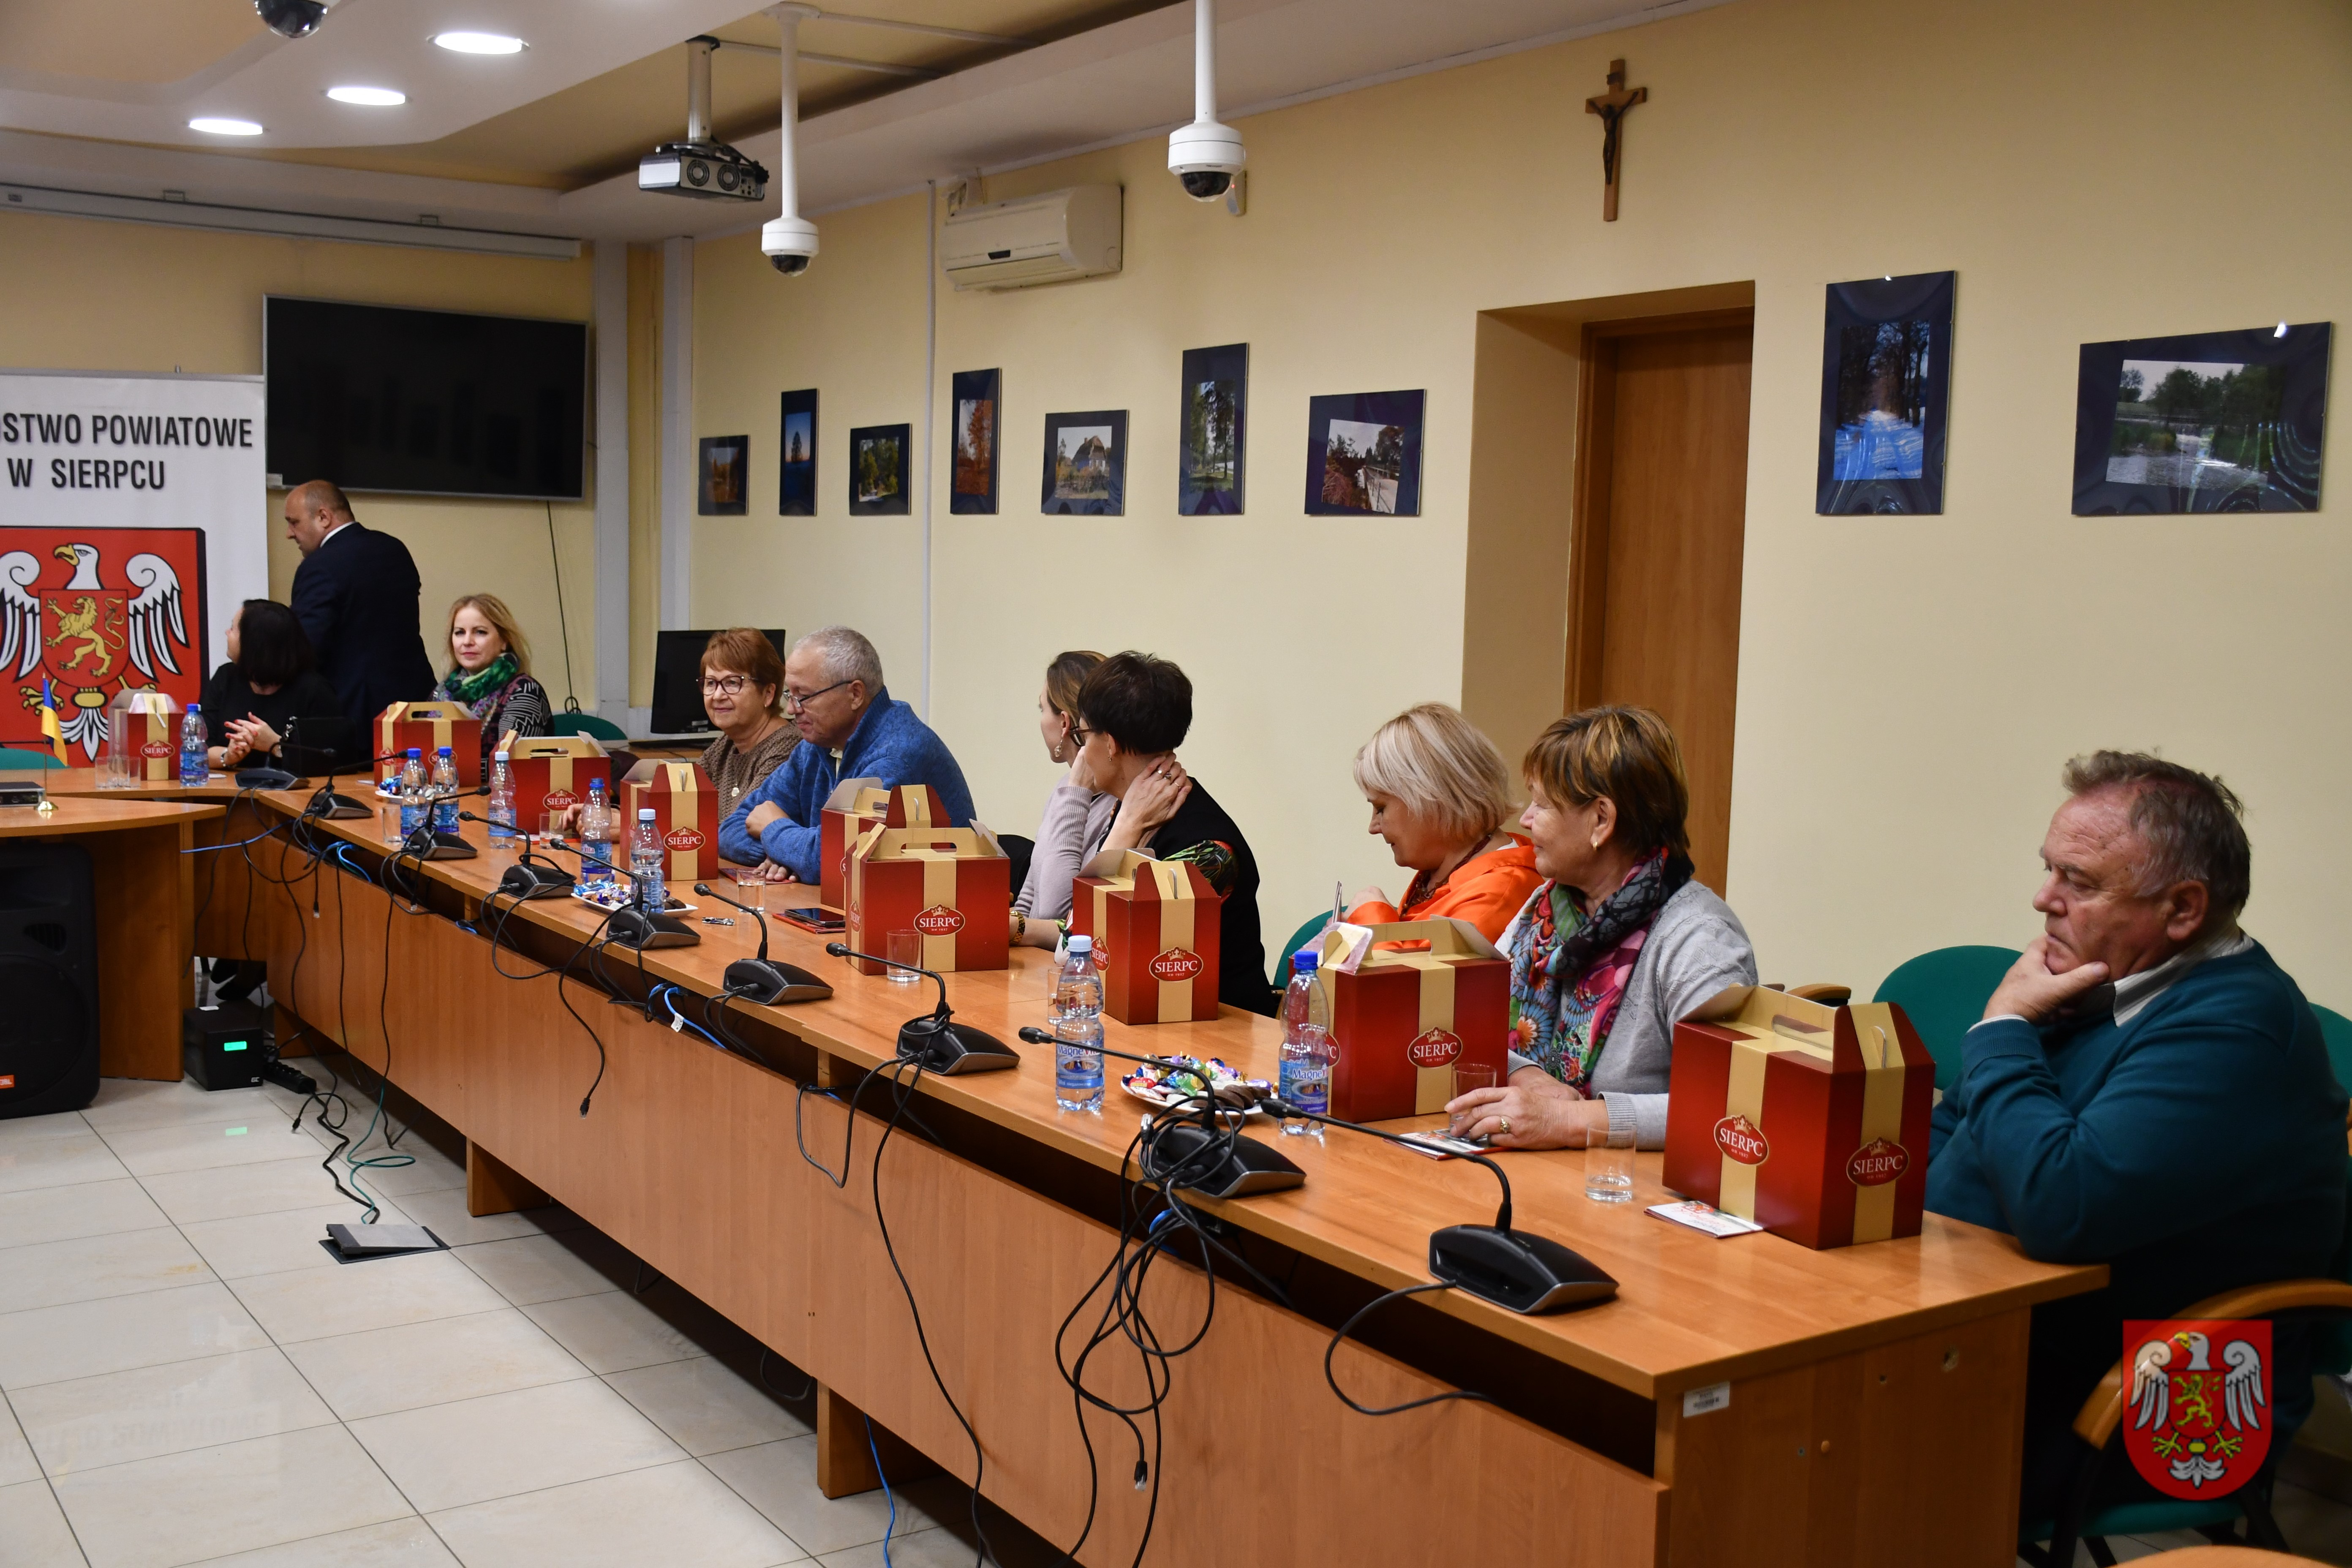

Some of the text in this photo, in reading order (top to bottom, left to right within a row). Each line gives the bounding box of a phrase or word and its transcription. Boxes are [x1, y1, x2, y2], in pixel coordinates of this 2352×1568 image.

[3, 413, 253, 447] STWO POWIATOWE
[7, 458, 165, 489] W SIERPCU
[144, 746, 172, 754] SIERPC
[547, 797, 576, 806] SIERPC
[668, 836, 701, 845] SIERPC
[919, 917, 960, 928] SIERPC
[1092, 947, 1108, 964] SIERPC
[1155, 960, 1198, 973] SIERPC
[1413, 1042, 1457, 1058] SIERPC
[1719, 1128, 1763, 1157] SIERPC
[1853, 1155, 1903, 1175] SIERPC
